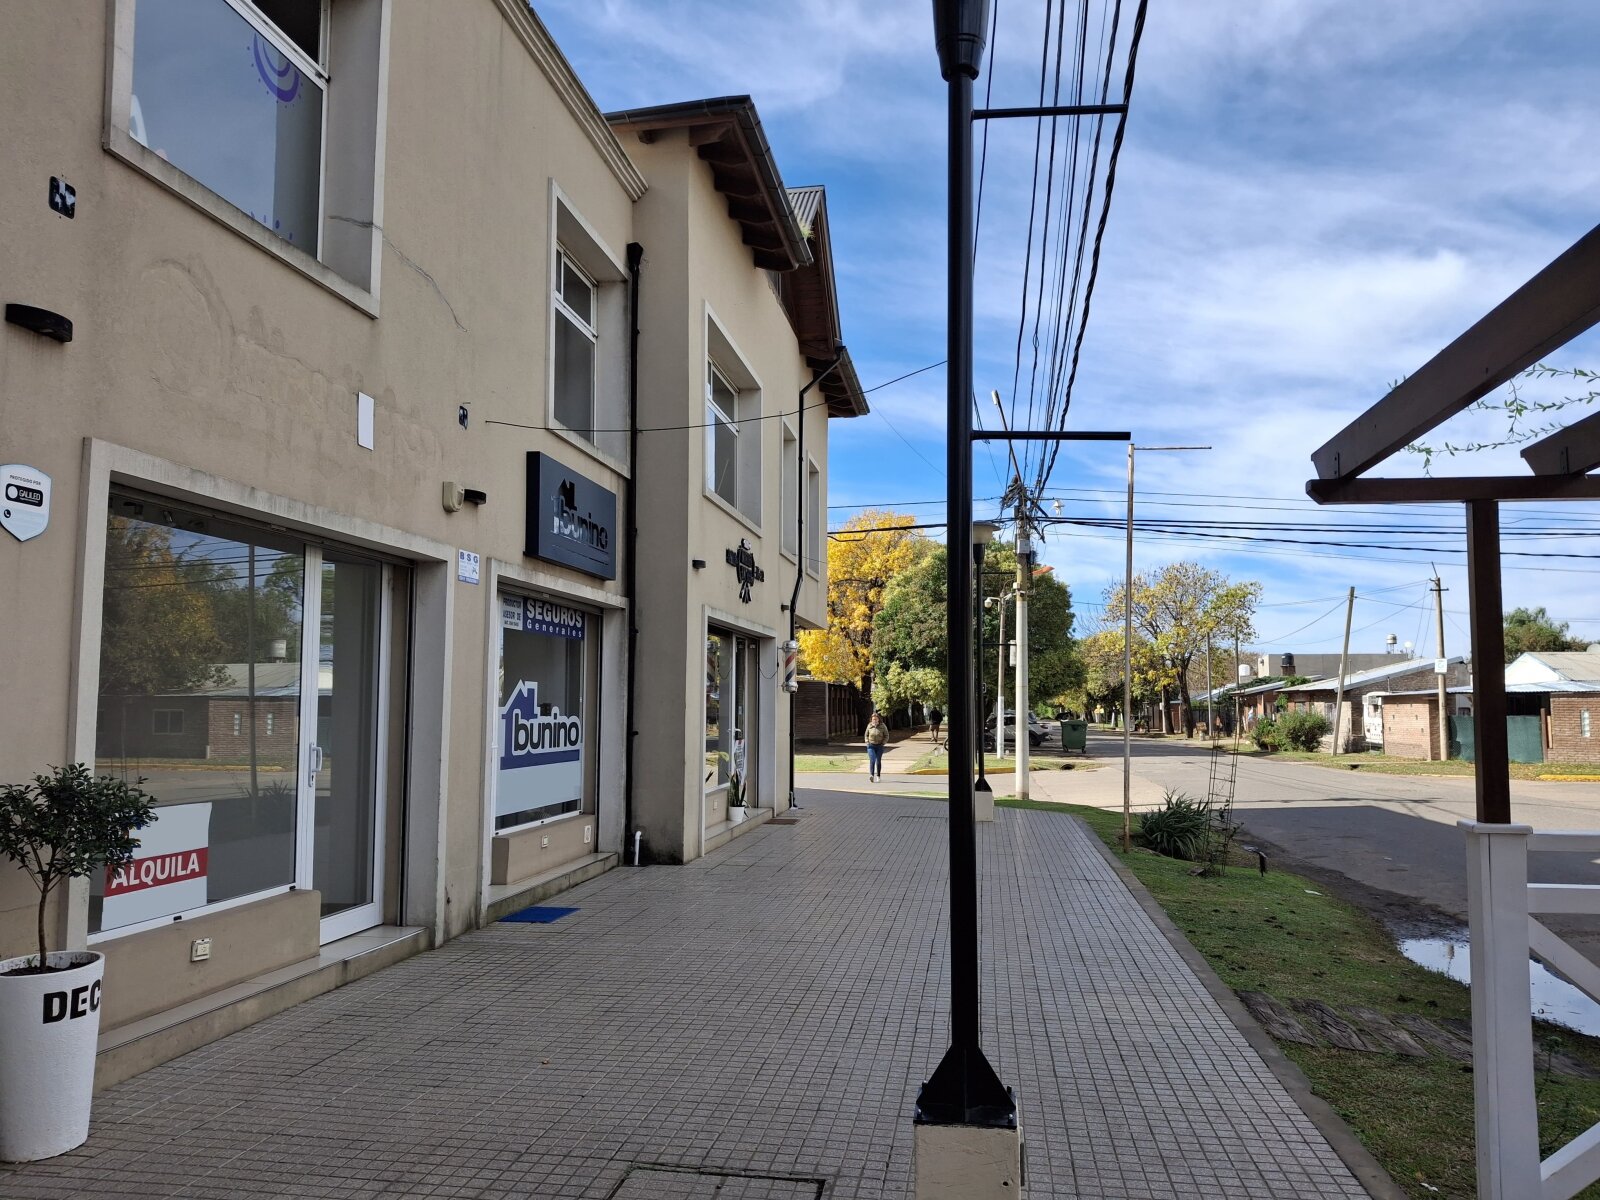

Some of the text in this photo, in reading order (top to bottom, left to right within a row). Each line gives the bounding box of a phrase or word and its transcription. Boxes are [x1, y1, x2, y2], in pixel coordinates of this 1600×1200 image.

[19, 489, 41, 500] GALILEO
[560, 498, 608, 549] bunino
[527, 599, 582, 628] SEGUROS
[527, 619, 581, 638] Generales
[514, 713, 579, 752] bunino
[111, 852, 199, 889] ALQUILA
[43, 979, 102, 1024] DEC
